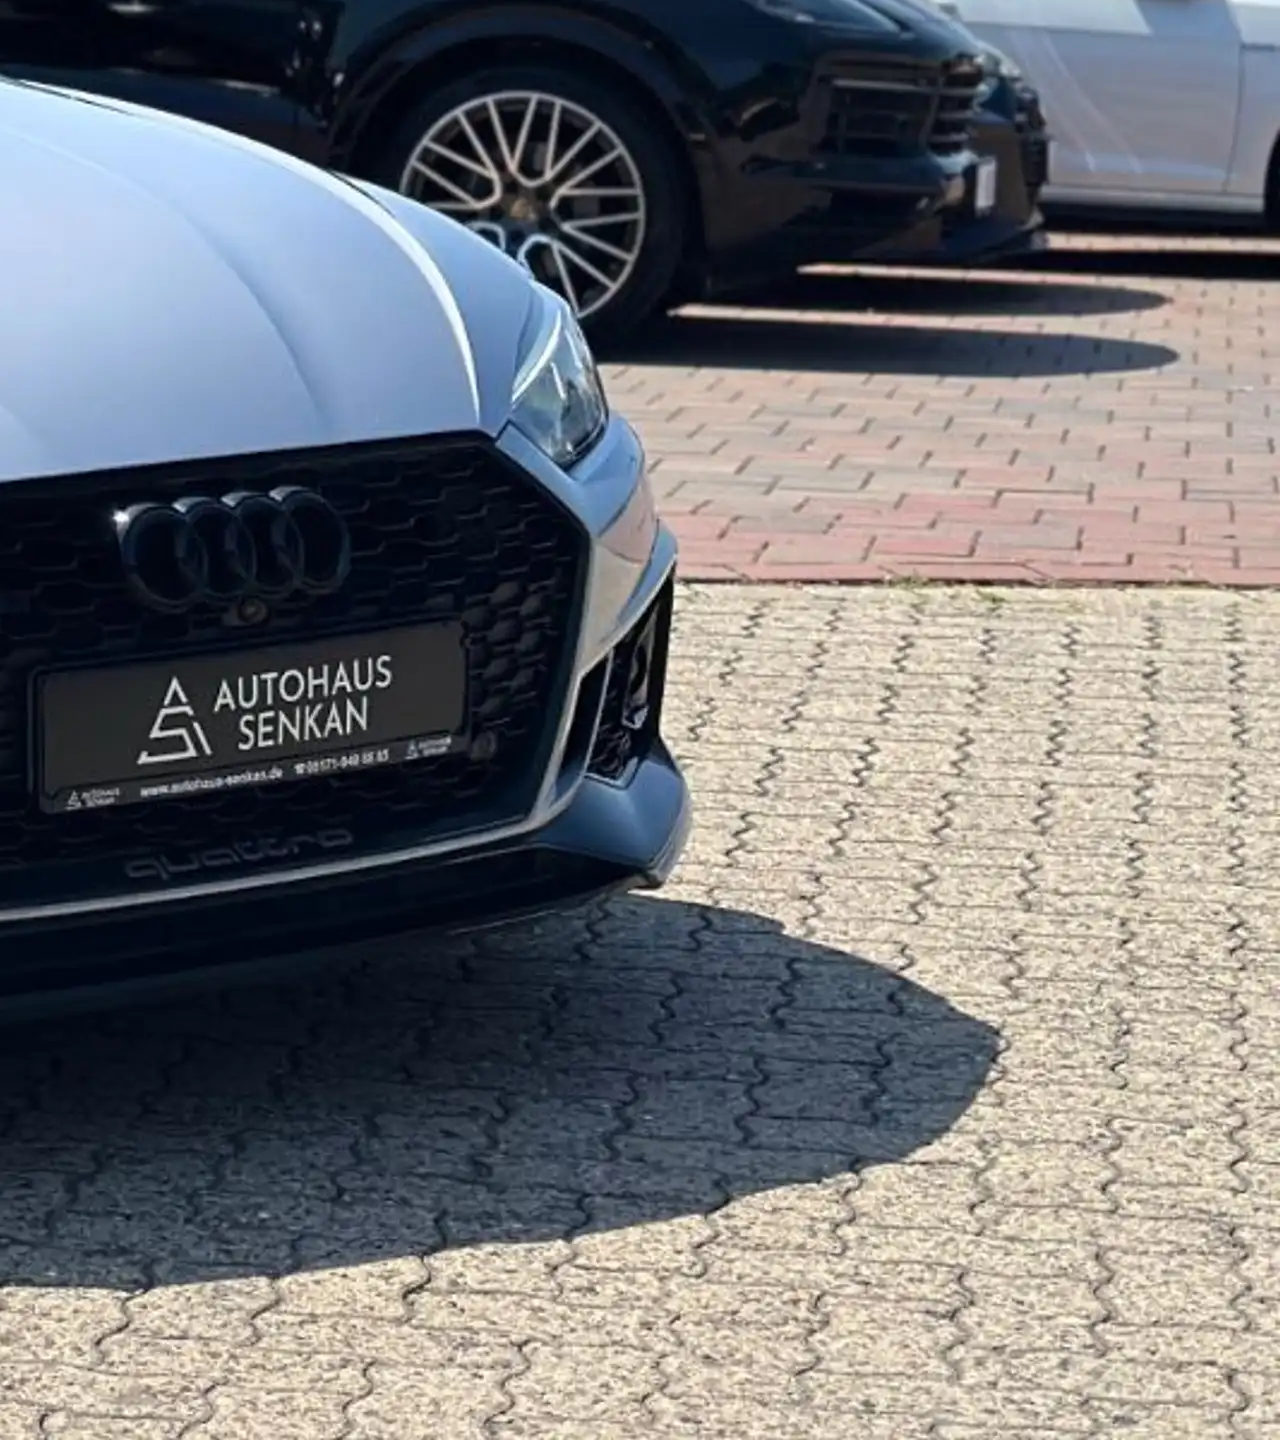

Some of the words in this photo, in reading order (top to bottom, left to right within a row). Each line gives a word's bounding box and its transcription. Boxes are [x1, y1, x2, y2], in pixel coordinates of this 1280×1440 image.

[213, 654, 394, 714] AUTOHAUS
[237, 696, 369, 752] SENKAN
[124, 828, 354, 881] quattro
